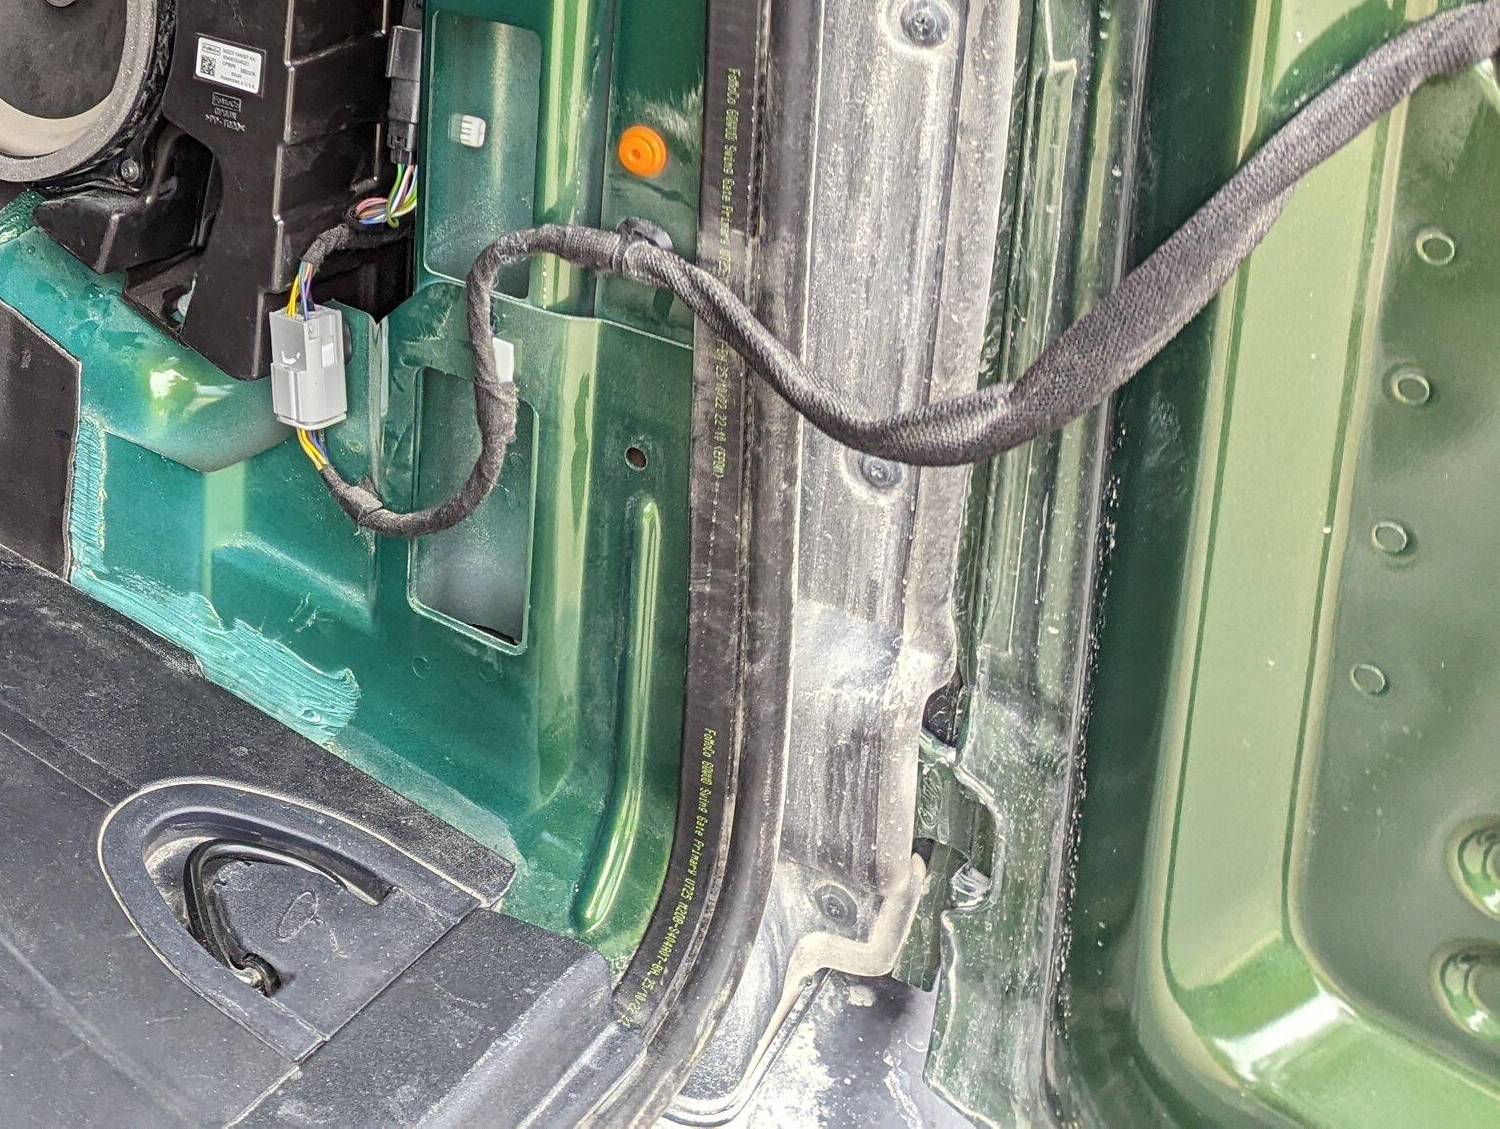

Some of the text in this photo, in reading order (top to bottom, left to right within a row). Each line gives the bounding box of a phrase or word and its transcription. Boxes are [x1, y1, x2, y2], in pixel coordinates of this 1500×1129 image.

[702, 727, 717, 758] FoMoCo
[697, 787, 712, 813] Swing
[694, 815, 708, 837] Gate
[688, 838, 704, 876] Primary
[680, 878, 697, 901] U725
